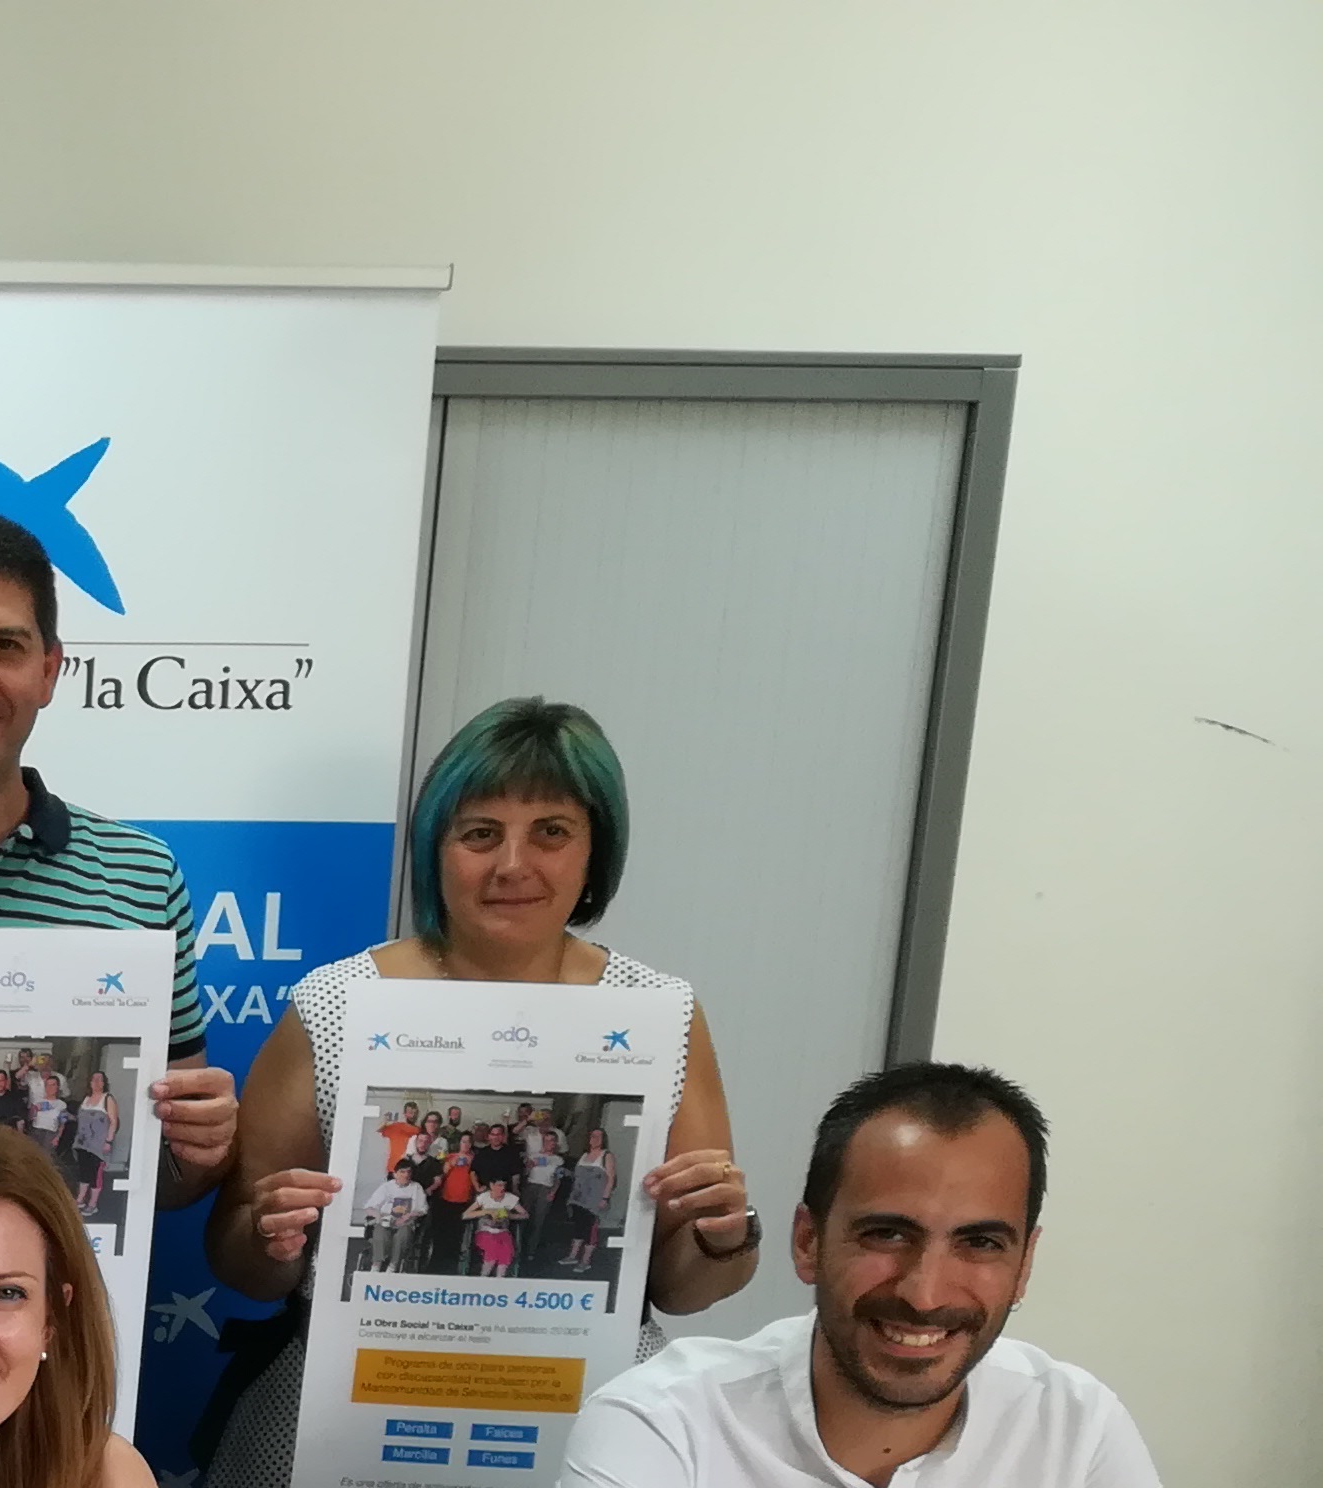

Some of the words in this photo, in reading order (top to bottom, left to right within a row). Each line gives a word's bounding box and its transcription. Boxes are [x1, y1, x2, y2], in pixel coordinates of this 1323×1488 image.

[136, 656, 314, 712] Caixa"
[396, 1034, 466, 1050] CaixaBank
[364, 1285, 508, 1306] Necesitamos
[514, 1291, 573, 1309] 4.500
[579, 1293, 593, 1309] €
